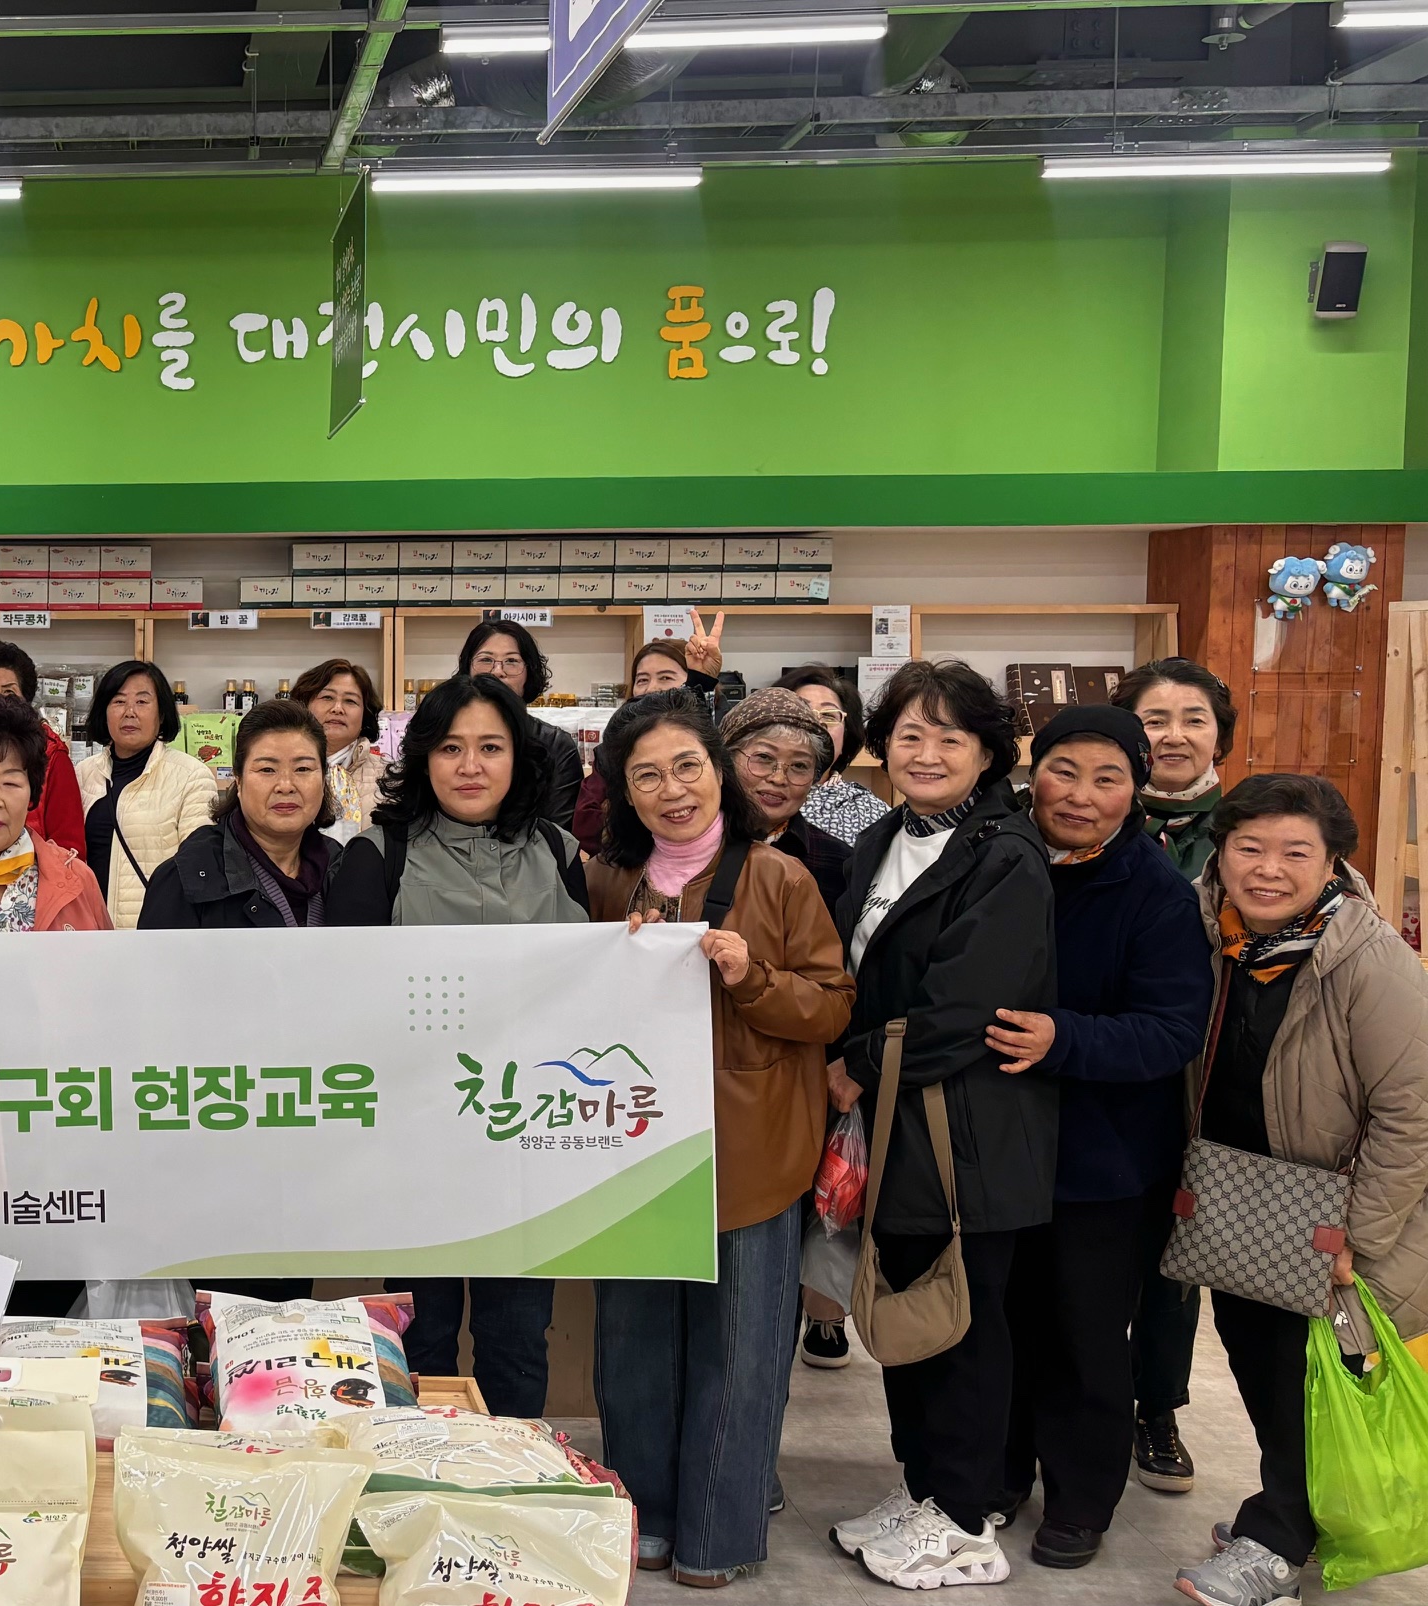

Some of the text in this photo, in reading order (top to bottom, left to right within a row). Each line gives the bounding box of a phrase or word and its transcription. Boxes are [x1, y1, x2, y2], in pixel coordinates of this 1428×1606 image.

[658, 285, 836, 380] 품으로!
[2, 613, 47, 626] 작두콩차
[504, 612, 548, 622] 아카시아 꿀
[133, 1063, 378, 1132] 현장교육
[454, 1052, 664, 1142] 칠갑마루
[519, 1135, 624, 1150] 청양군 공동브랜드
[227, 1328, 256, 1344] 10kg
[272, 1376, 327, 1400] 황금
[277, 1403, 327, 1420] 친환경
[204, 1491, 272, 1527] 칠갑마루
[165, 1532, 237, 1565] 청양쌀
